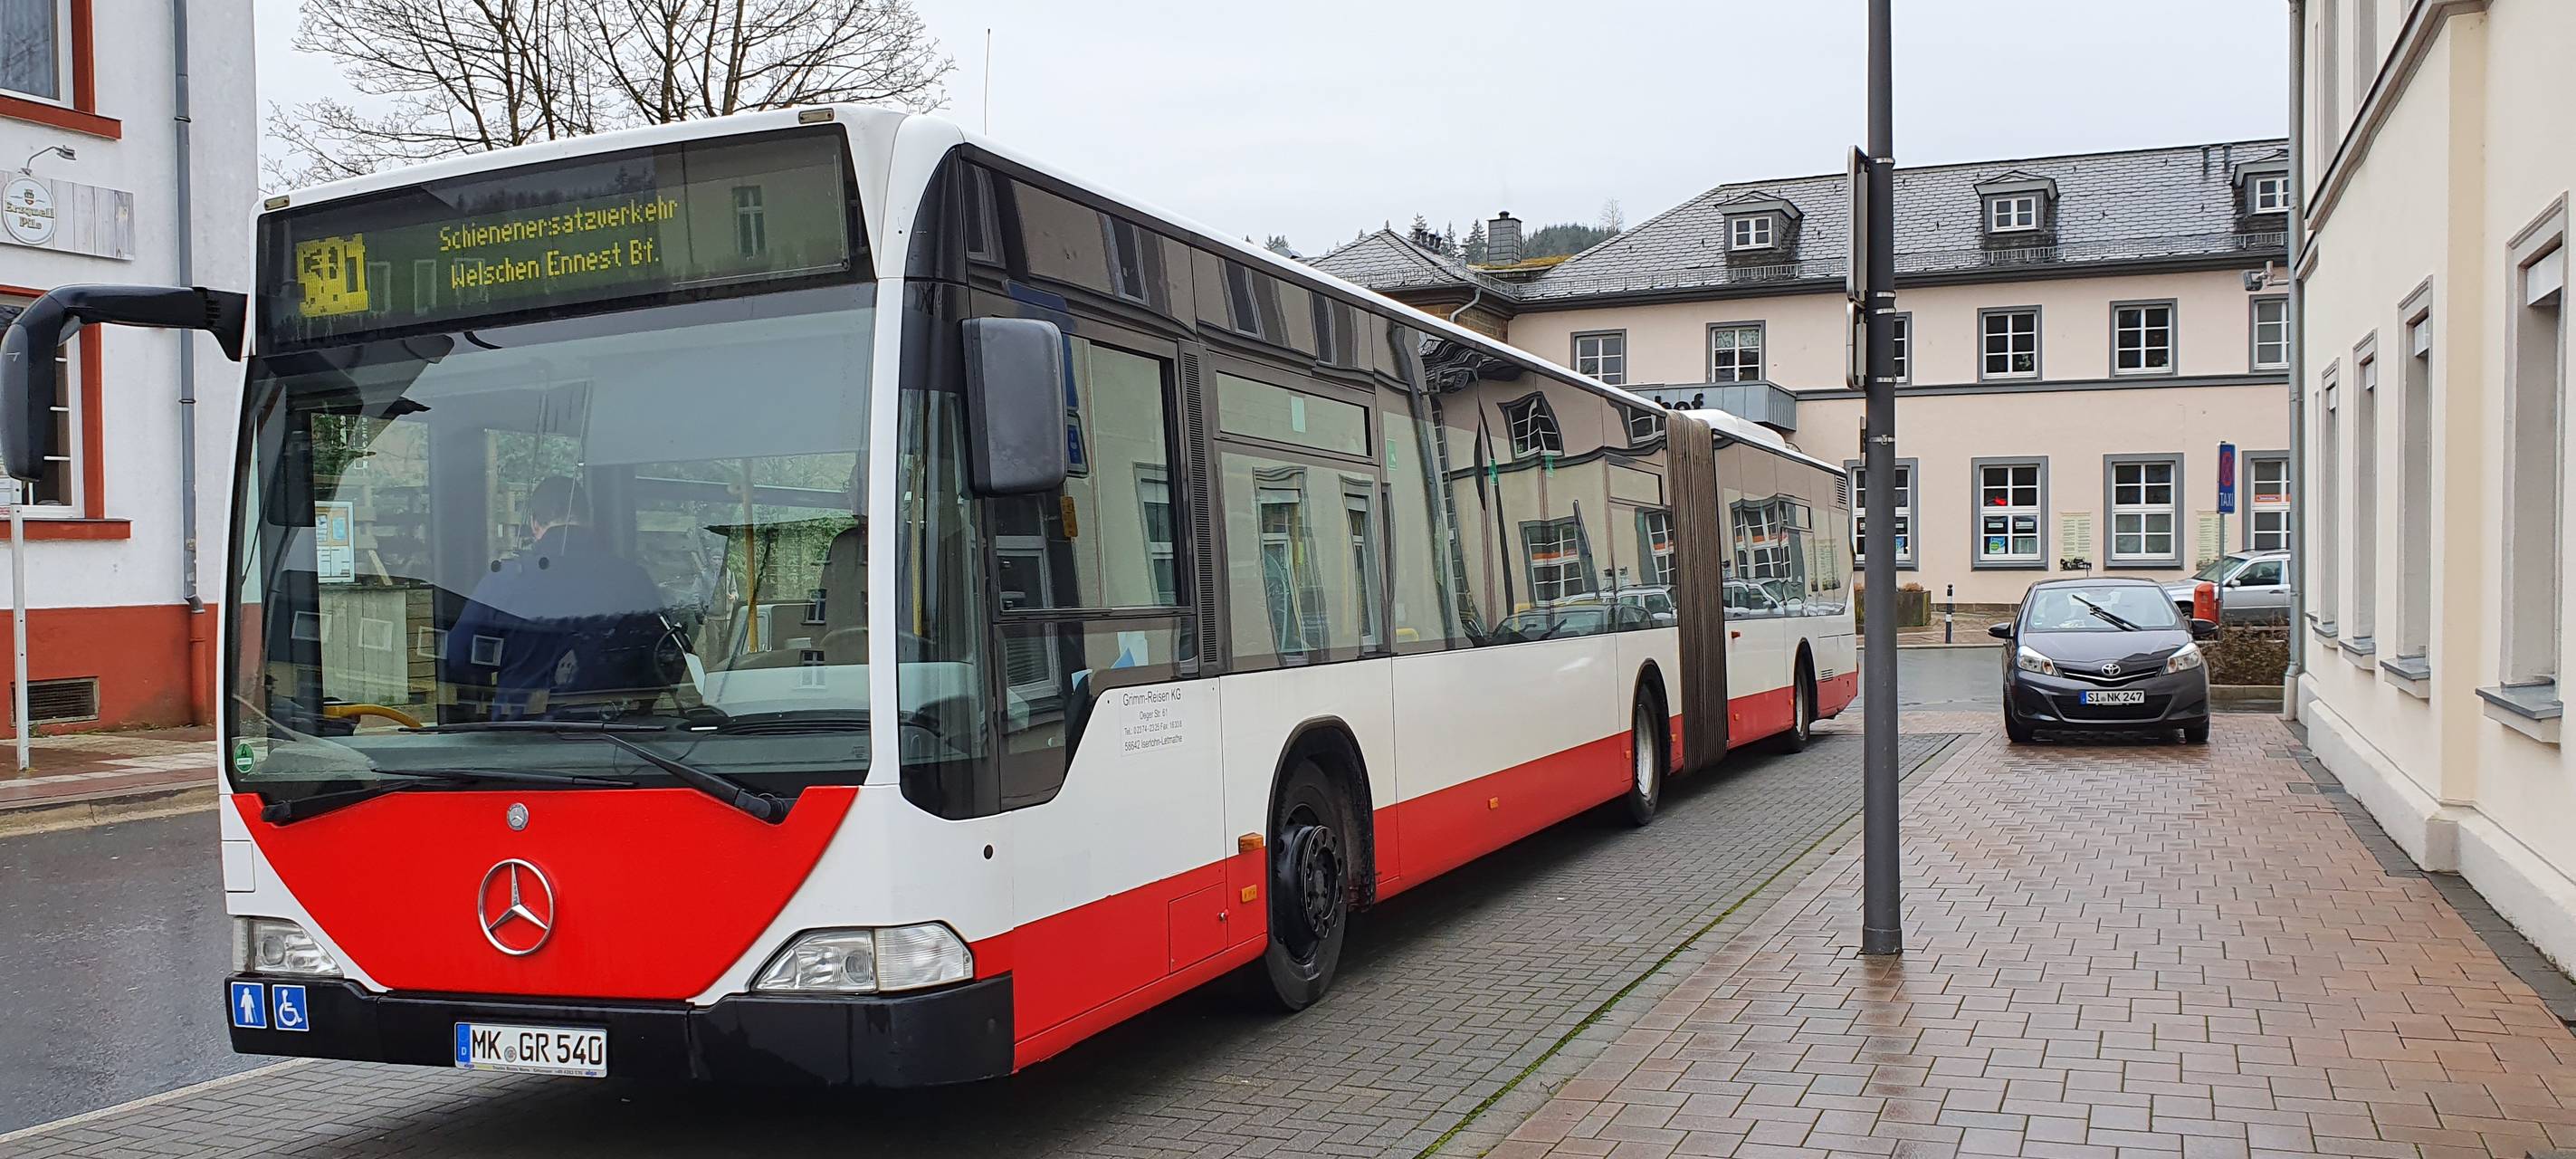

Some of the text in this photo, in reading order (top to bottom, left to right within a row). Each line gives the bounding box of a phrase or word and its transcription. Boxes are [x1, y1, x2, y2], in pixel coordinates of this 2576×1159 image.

[5, 201, 55, 218] Erzquell
[19, 216, 43, 229] Pils
[440, 196, 678, 251] Schienenersatzverkehr
[452, 237, 660, 289] Welschen Ennest Bf.
[2219, 493, 2234, 507] TAXI
[1122, 688, 1181, 706] Grimm-Reisen KG
[2087, 692, 2142, 702] SI NK 247
[461, 1030, 603, 1066] D MK GR 540
